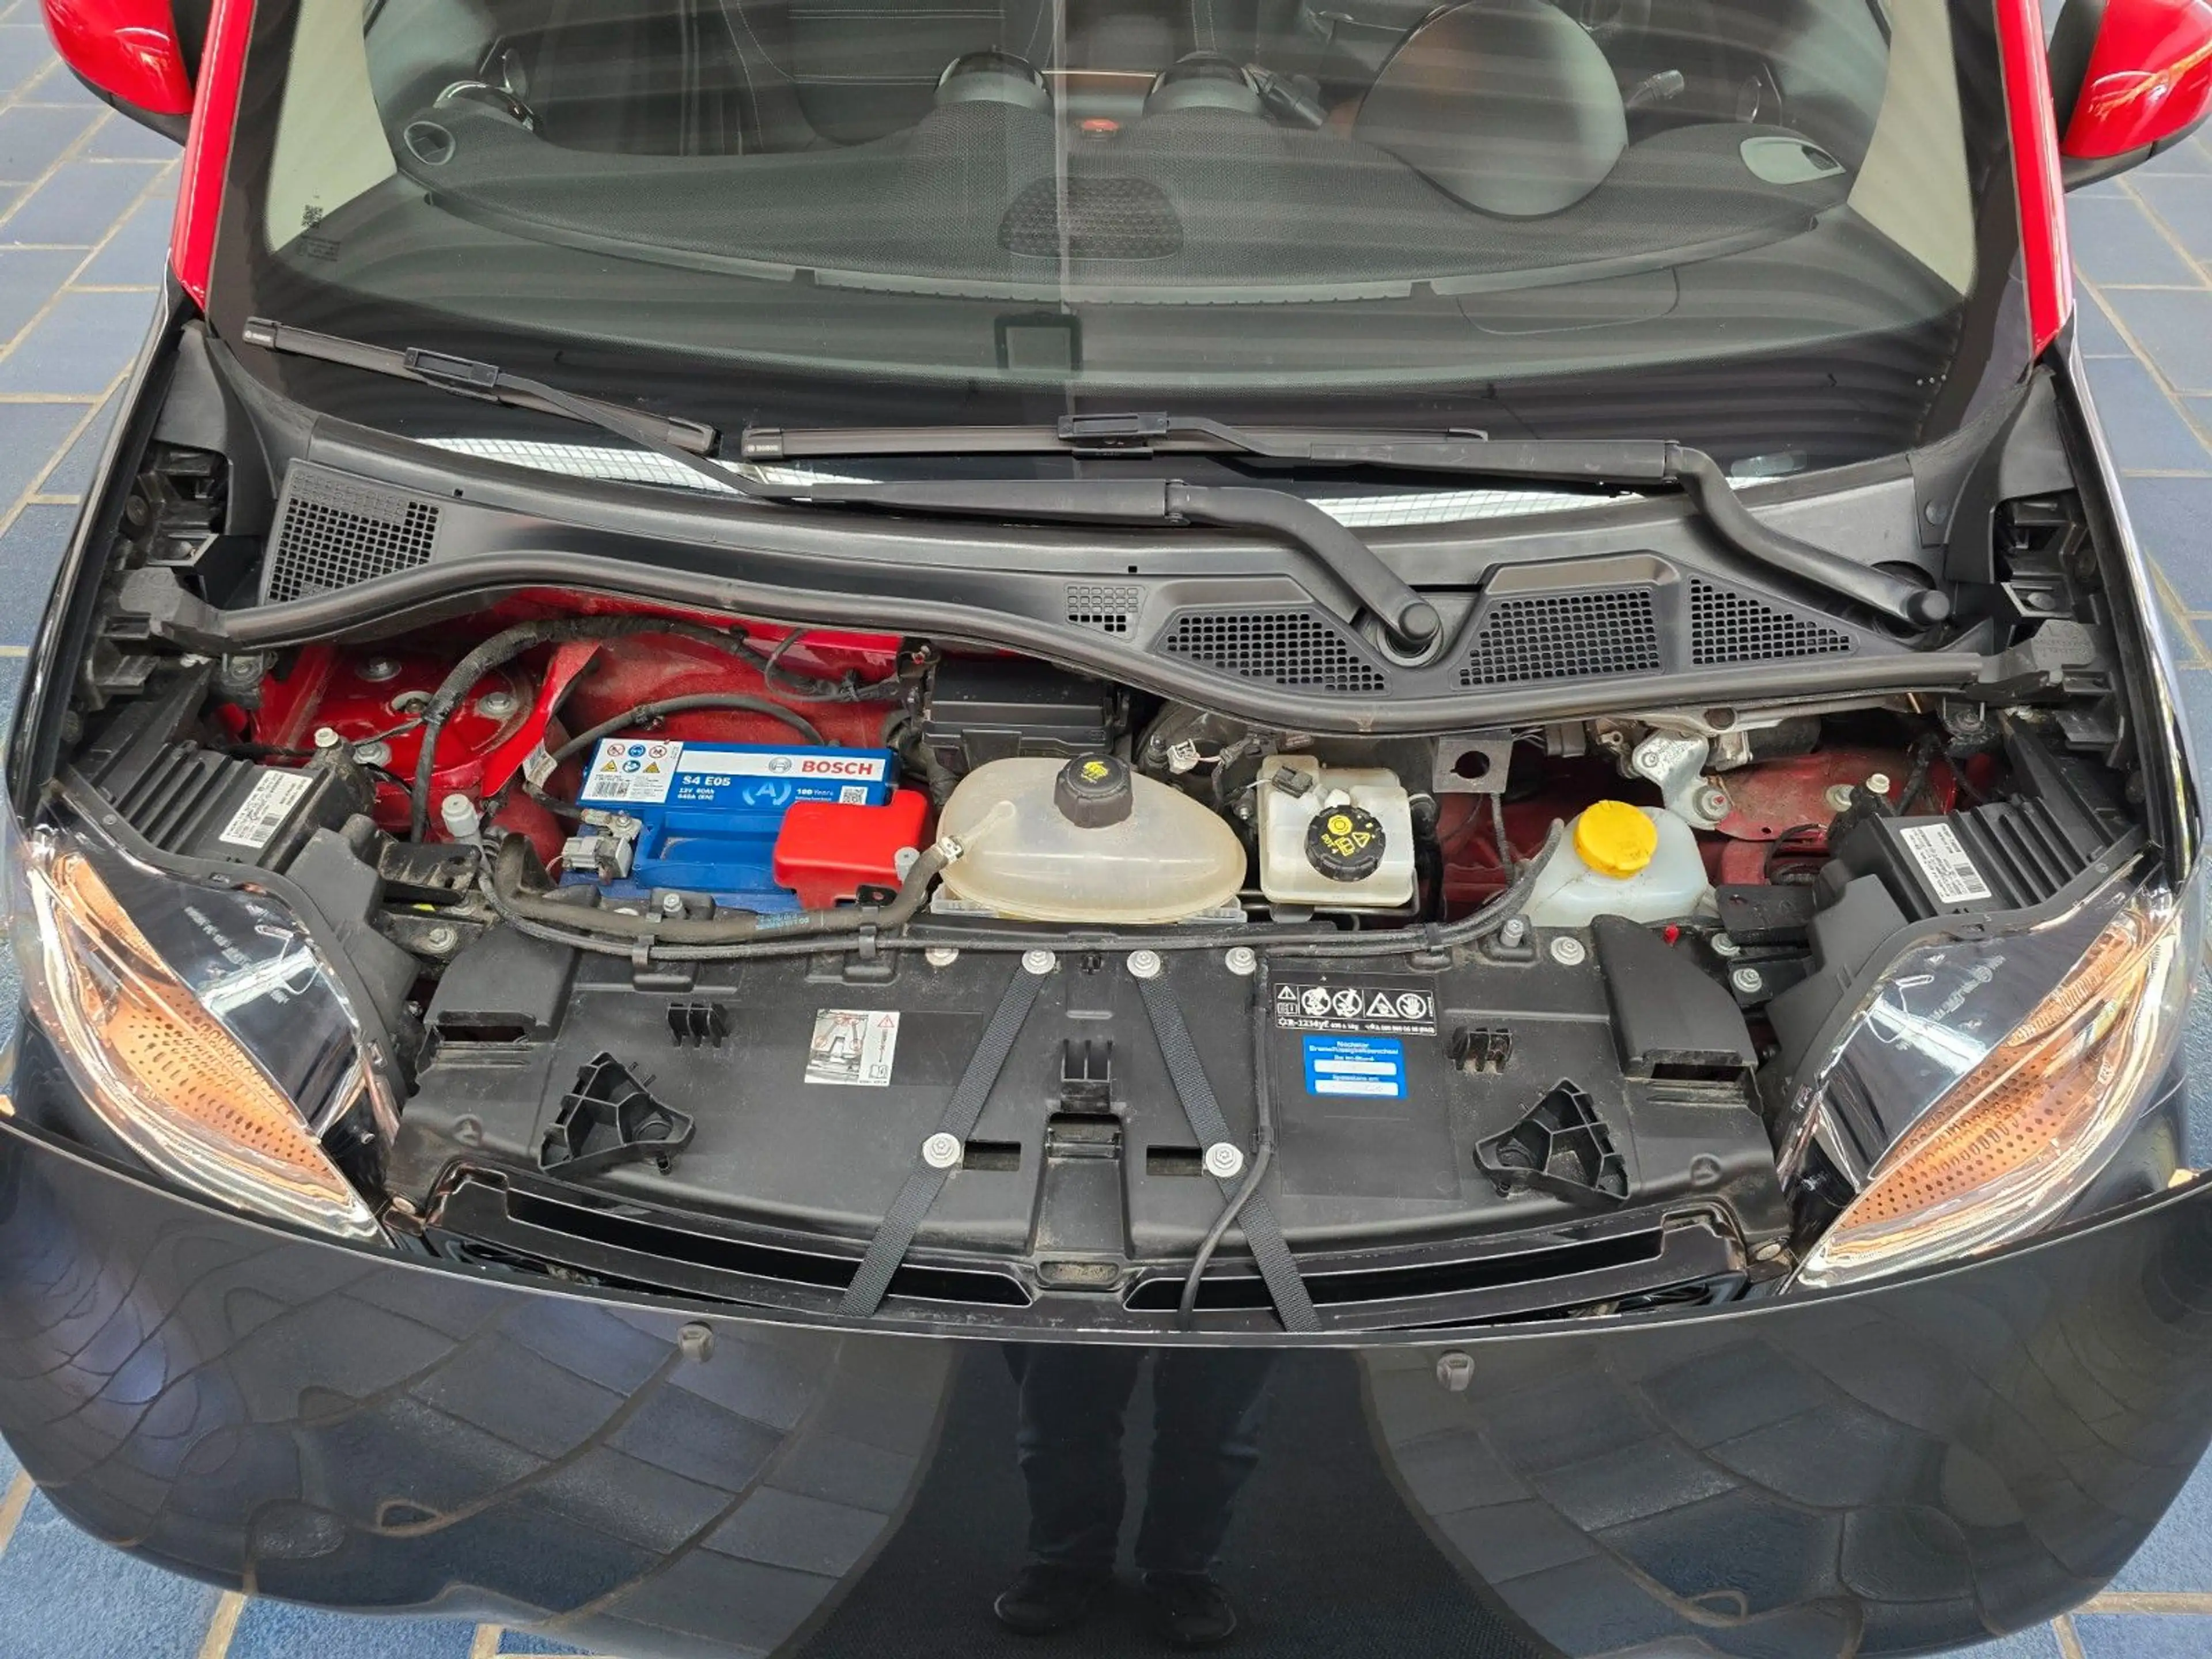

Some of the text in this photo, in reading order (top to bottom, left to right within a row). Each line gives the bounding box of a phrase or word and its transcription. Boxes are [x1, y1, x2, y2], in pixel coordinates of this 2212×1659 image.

[801, 760, 873, 775] BOSCH
[682, 775, 731, 787] S4 E05
